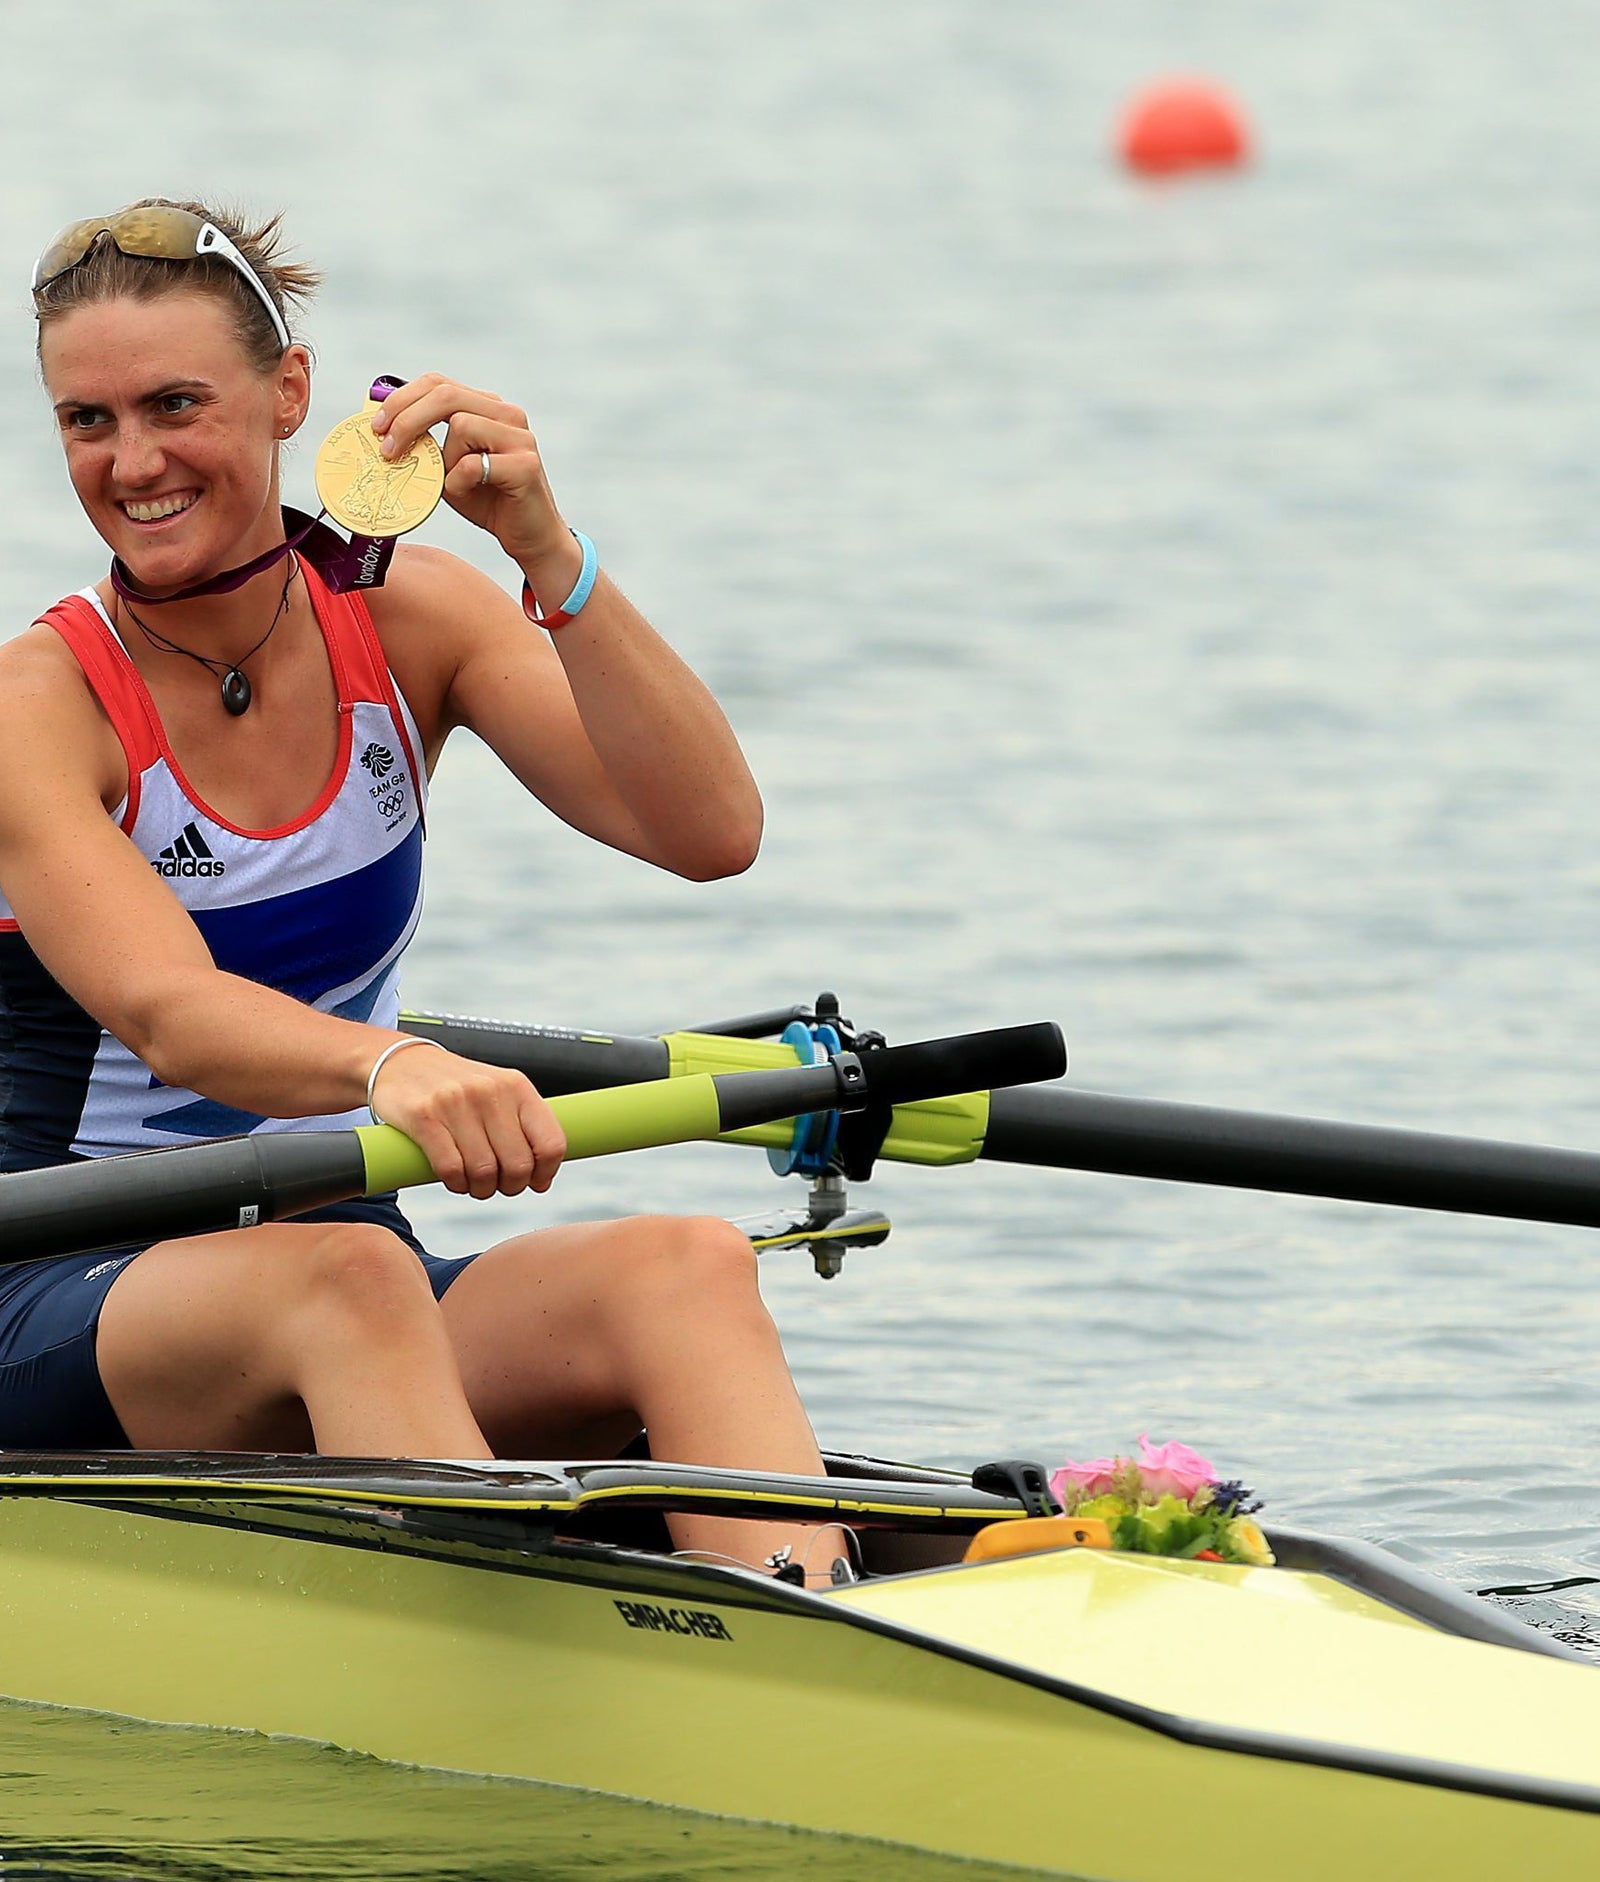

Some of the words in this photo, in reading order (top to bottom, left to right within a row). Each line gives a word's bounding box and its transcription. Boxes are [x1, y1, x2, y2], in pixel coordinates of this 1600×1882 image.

[353, 544, 381, 584] London
[369, 779, 391, 800] TEAM
[391, 772, 406, 786] GB
[612, 1599, 735, 1642] EMPACHER
